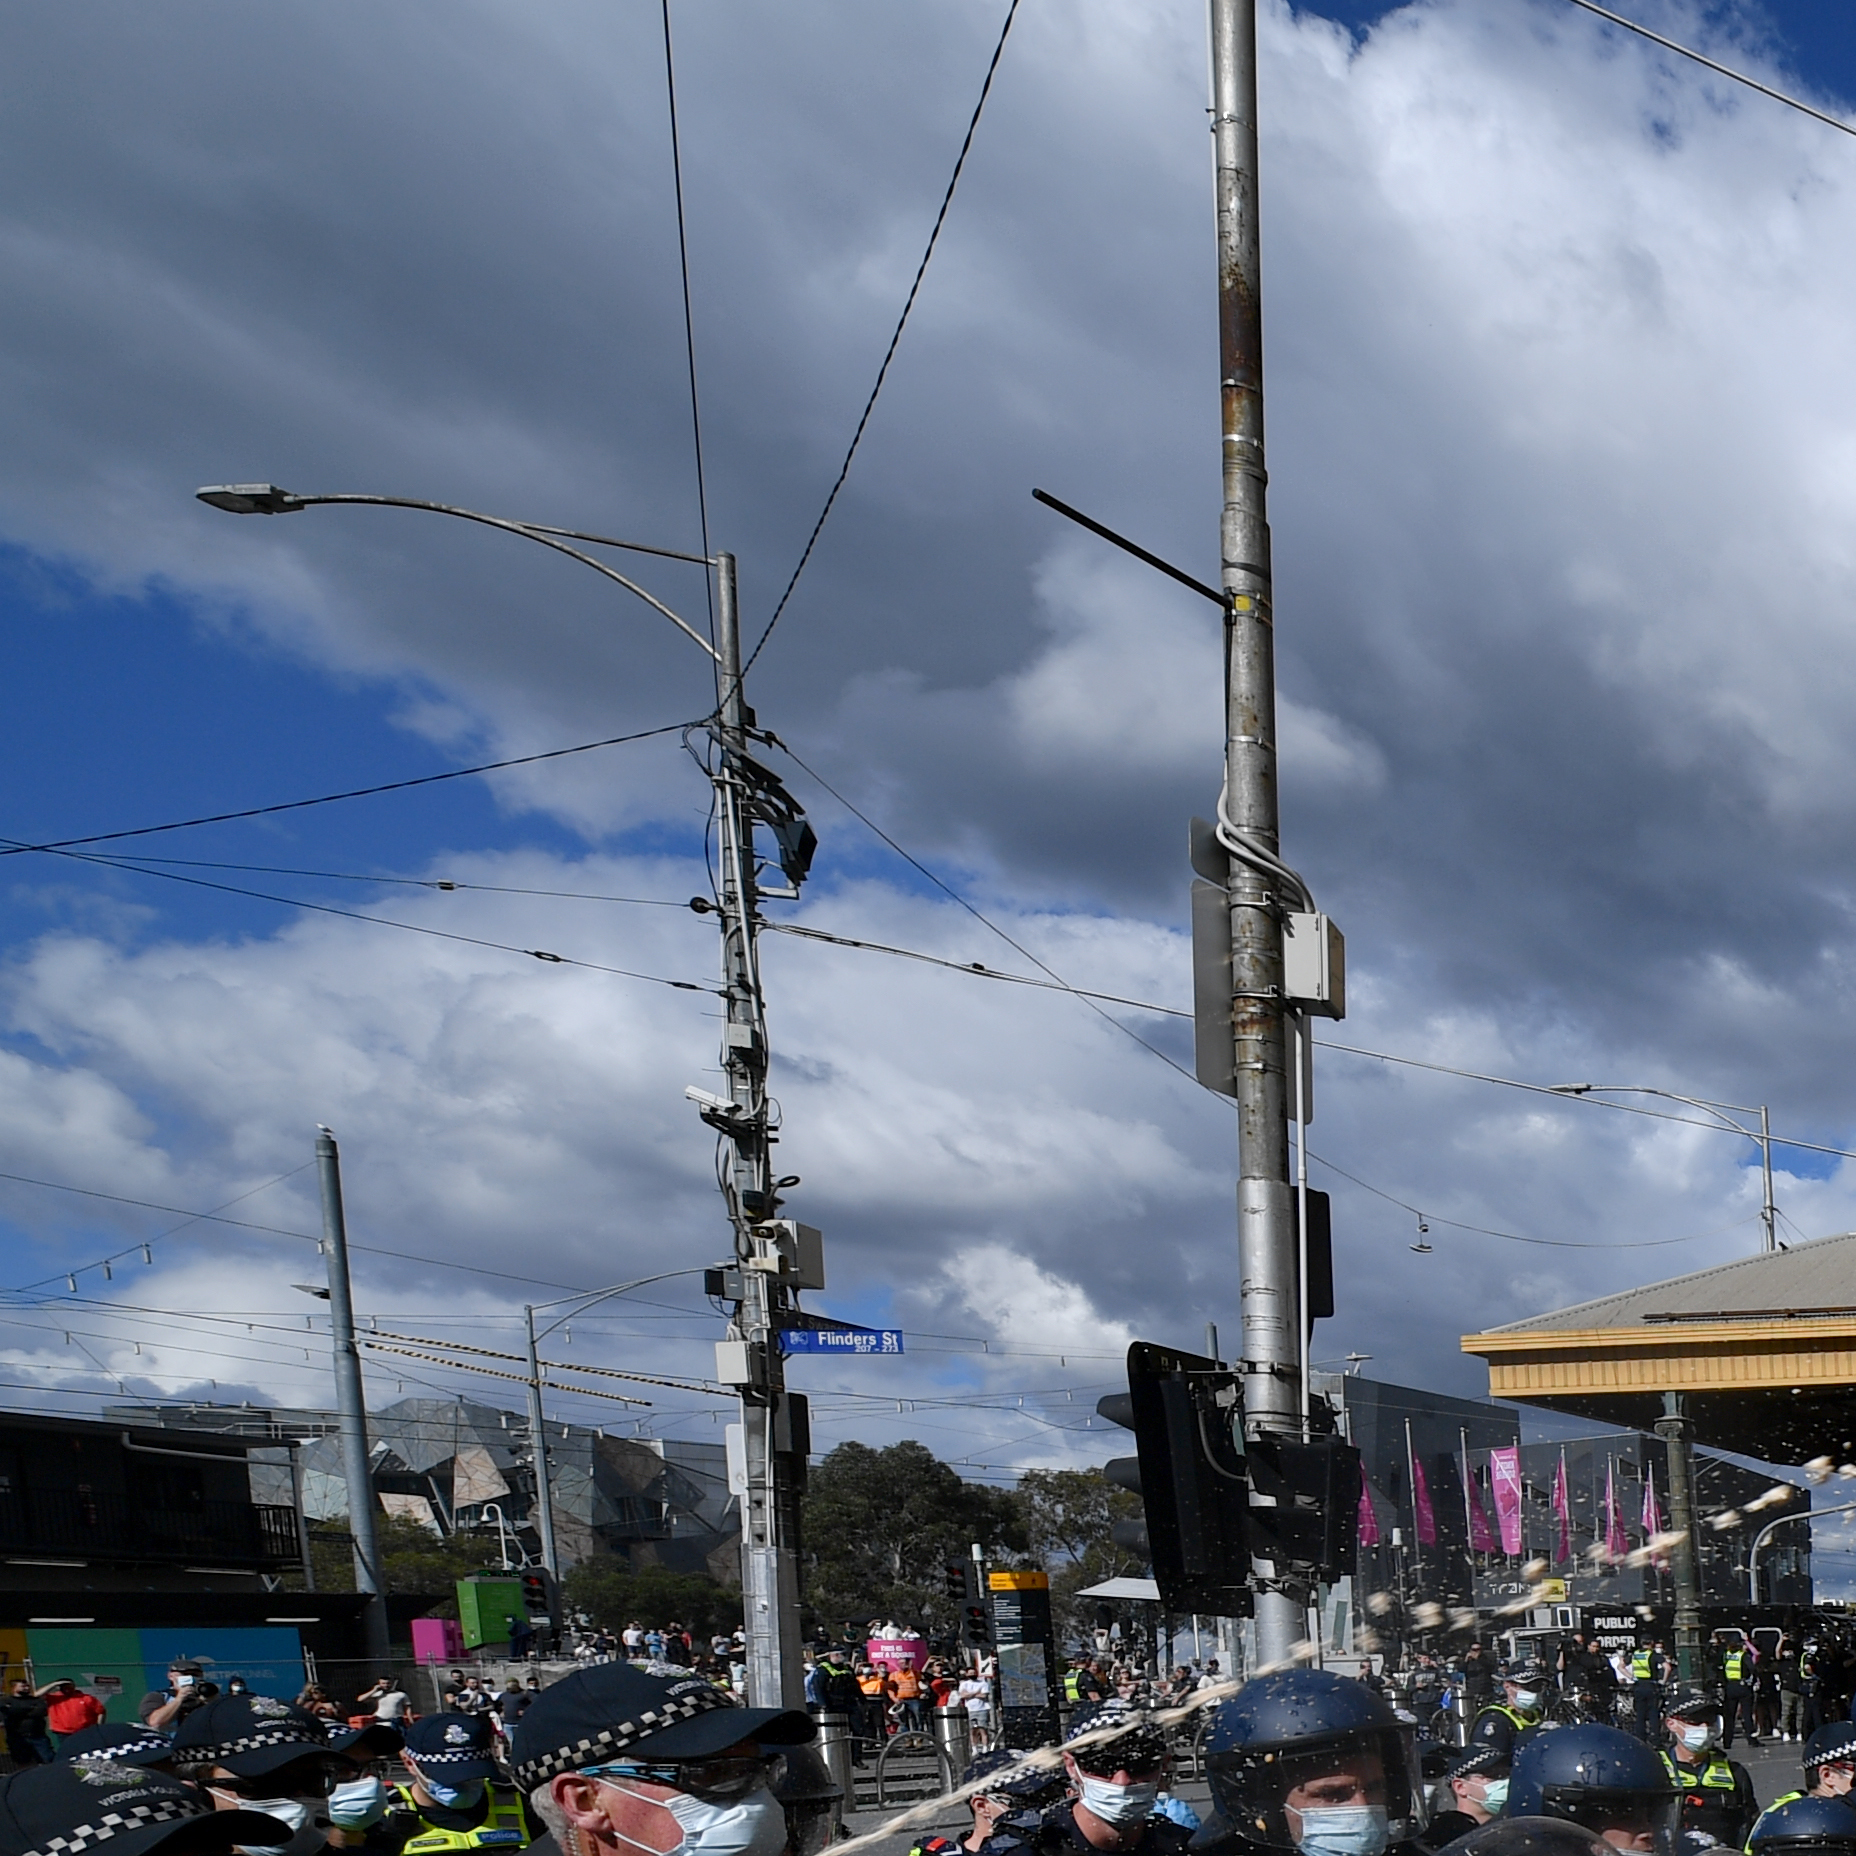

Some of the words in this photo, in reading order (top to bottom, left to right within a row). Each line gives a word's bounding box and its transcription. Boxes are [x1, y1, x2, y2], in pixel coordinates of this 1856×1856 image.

[818, 1331, 877, 1346] Flinders
[882, 1332, 898, 1345] St
[855, 1345, 871, 1353] 207
[882, 1345, 899, 1353] 273
[1593, 1616, 1637, 1629] PUBLIC
[481, 1831, 519, 1840] Police
